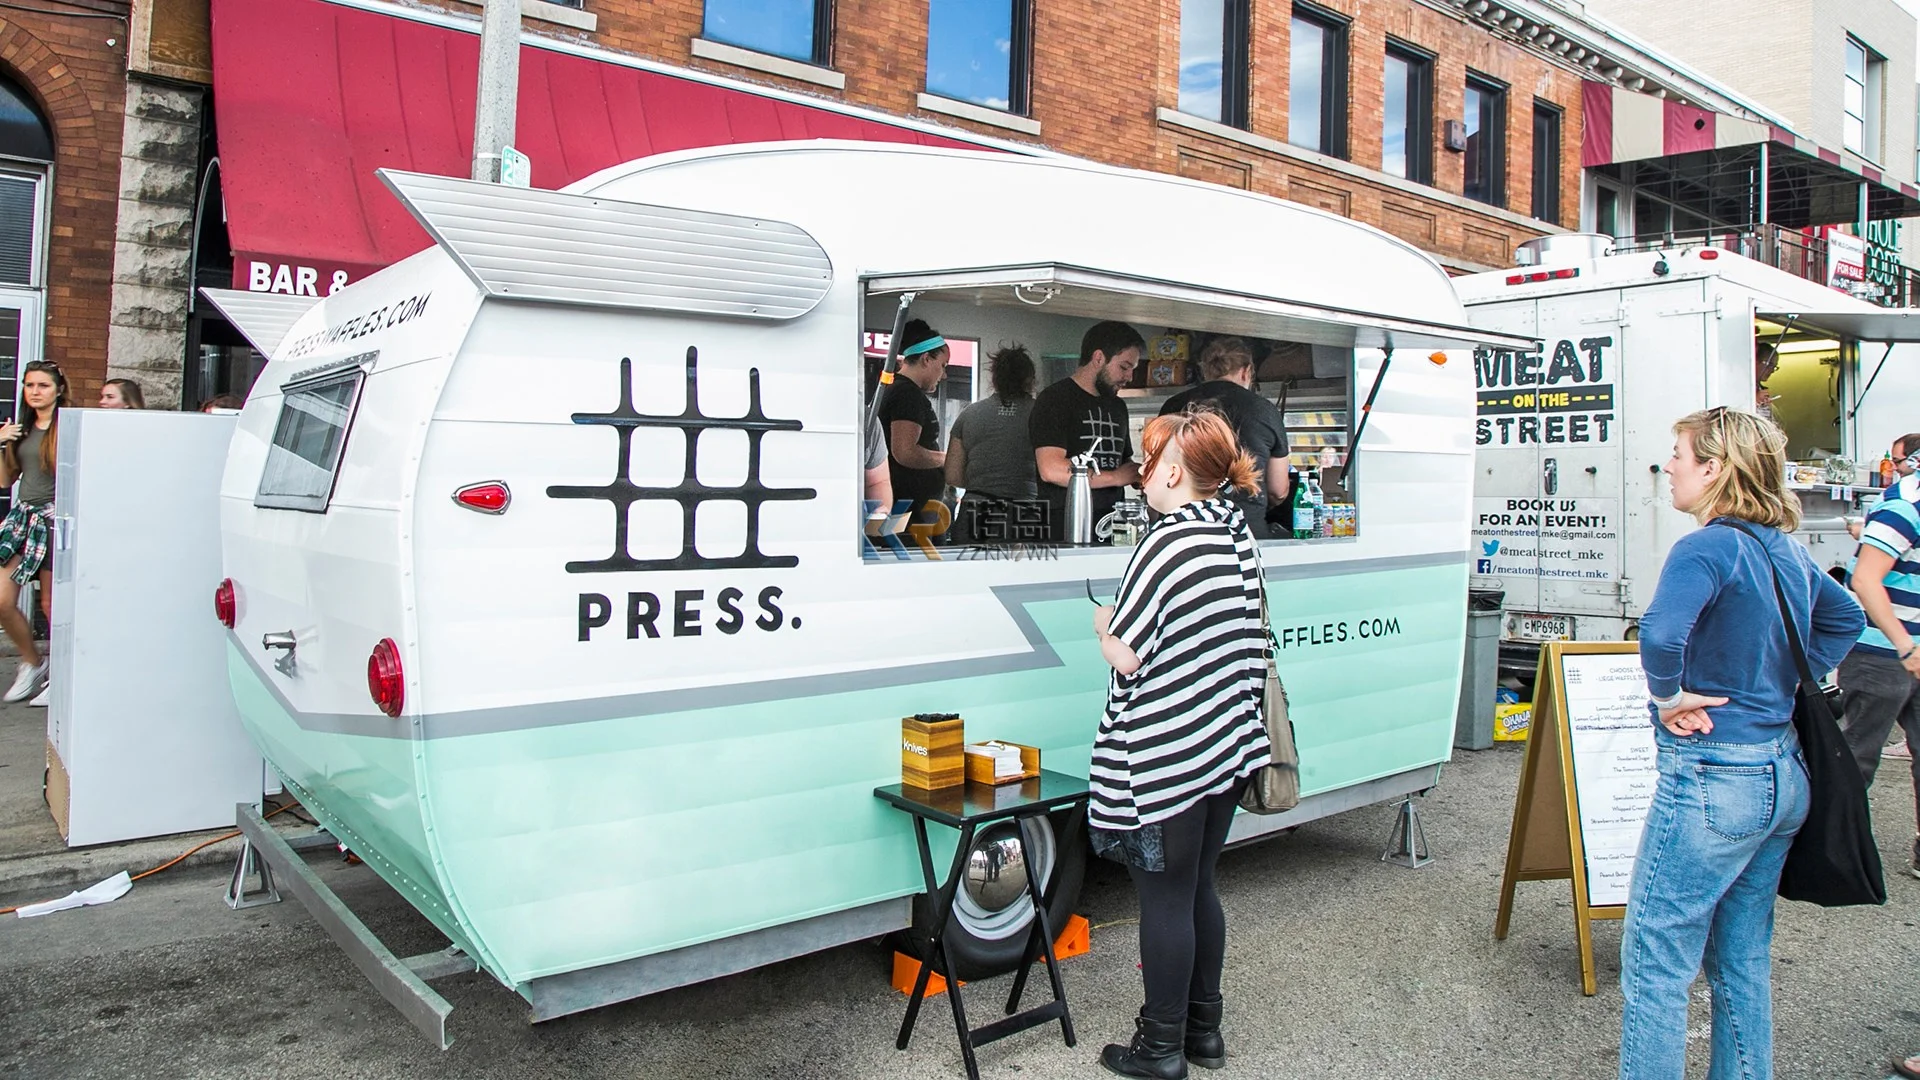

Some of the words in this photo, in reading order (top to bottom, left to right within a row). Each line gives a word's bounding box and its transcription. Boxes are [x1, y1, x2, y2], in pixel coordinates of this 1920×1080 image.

[249, 261, 318, 297] BAR
[1836, 262, 1849, 275] FOR
[1849, 265, 1864, 280] SALE
[1473, 336, 1612, 388] MEAT
[1512, 394, 1535, 408] ON
[1540, 393, 1570, 407] THE
[1476, 413, 1614, 446] STREET
[1507, 499, 1555, 512] BOOK
[1560, 500, 1576, 512] US
[1479, 514, 1511, 526] FOR
[1516, 514, 1538, 526] AN
[1545, 515, 1606, 528] EVENT!
[1471, 528, 1616, 541] meatonthestreet.mke@gmail.com
[578, 586, 802, 642] PRESS.
[903, 738, 928, 757] Knives
